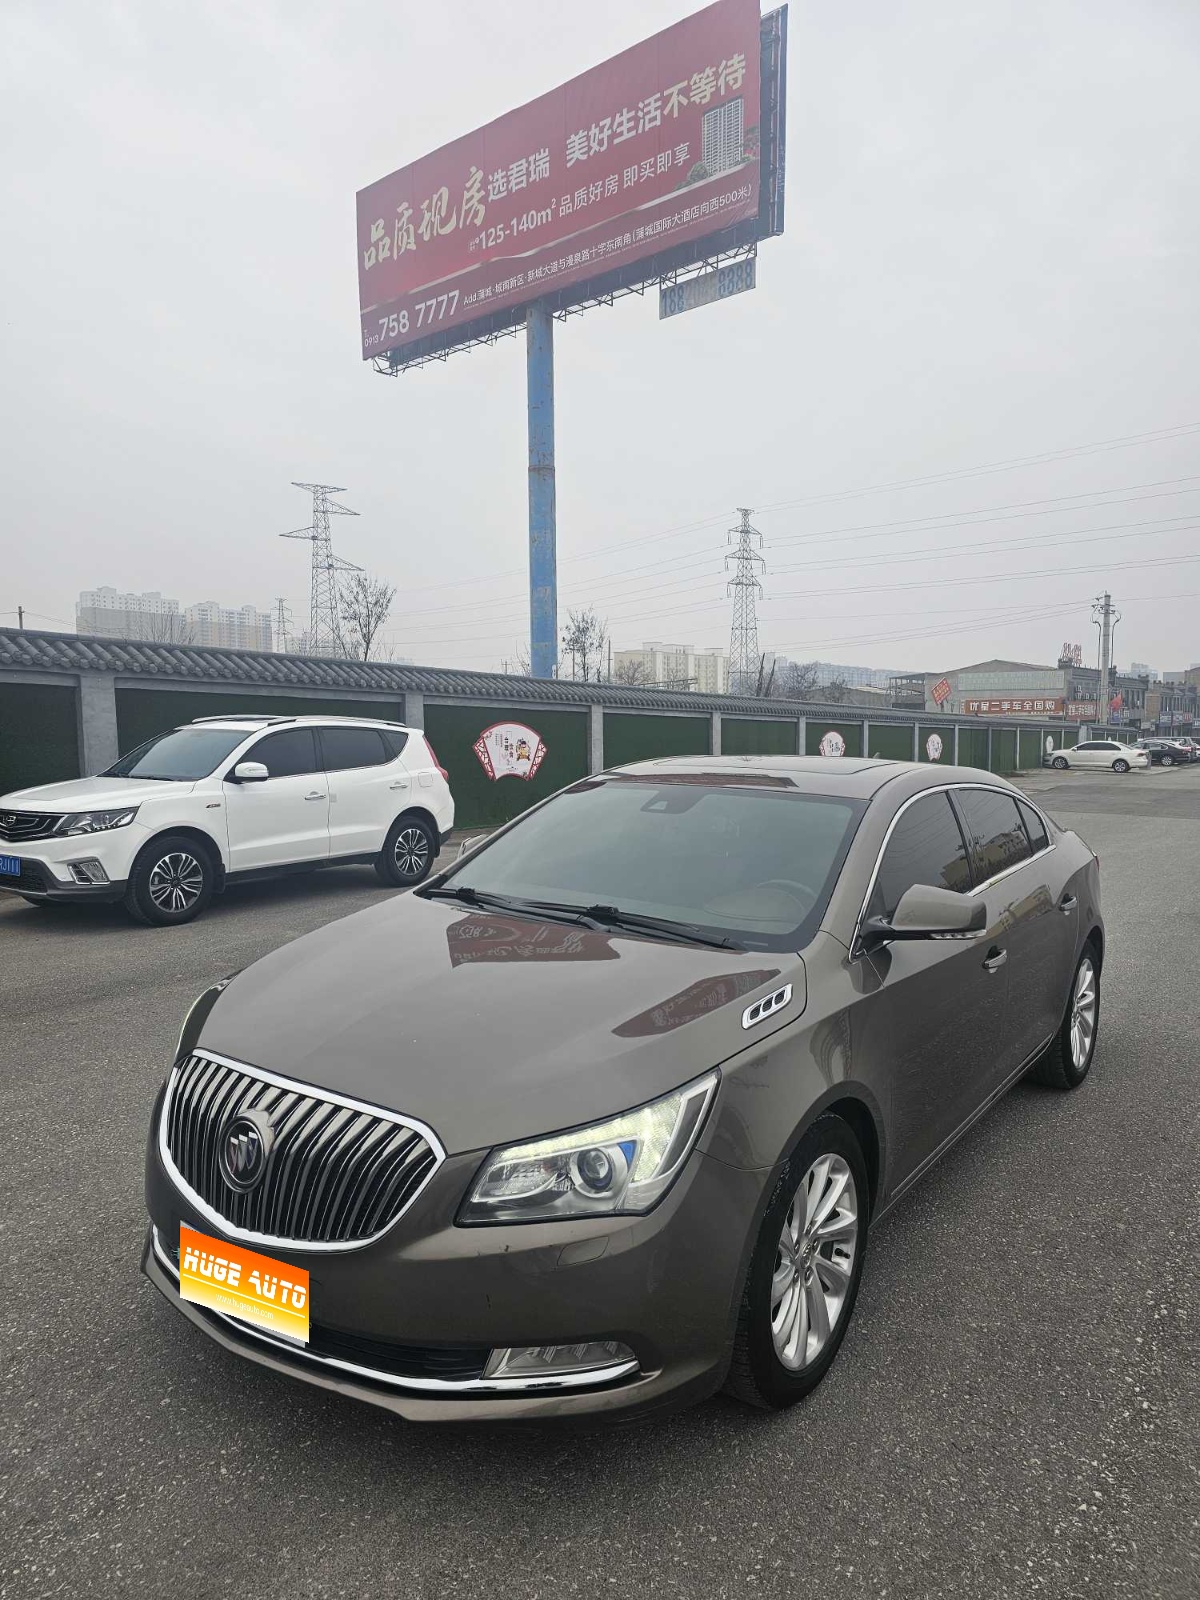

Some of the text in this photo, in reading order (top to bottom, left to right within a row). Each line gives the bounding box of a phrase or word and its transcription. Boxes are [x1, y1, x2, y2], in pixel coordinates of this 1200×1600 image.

[487, 147, 550, 203] 选君瑞
[566, 53, 746, 168] 美好生活不等待
[559, 174, 618, 217] 品质好房
[623, 142, 690, 189] 即买即享
[379, 310, 410, 341] 758
[415, 289, 460, 328] 7777
